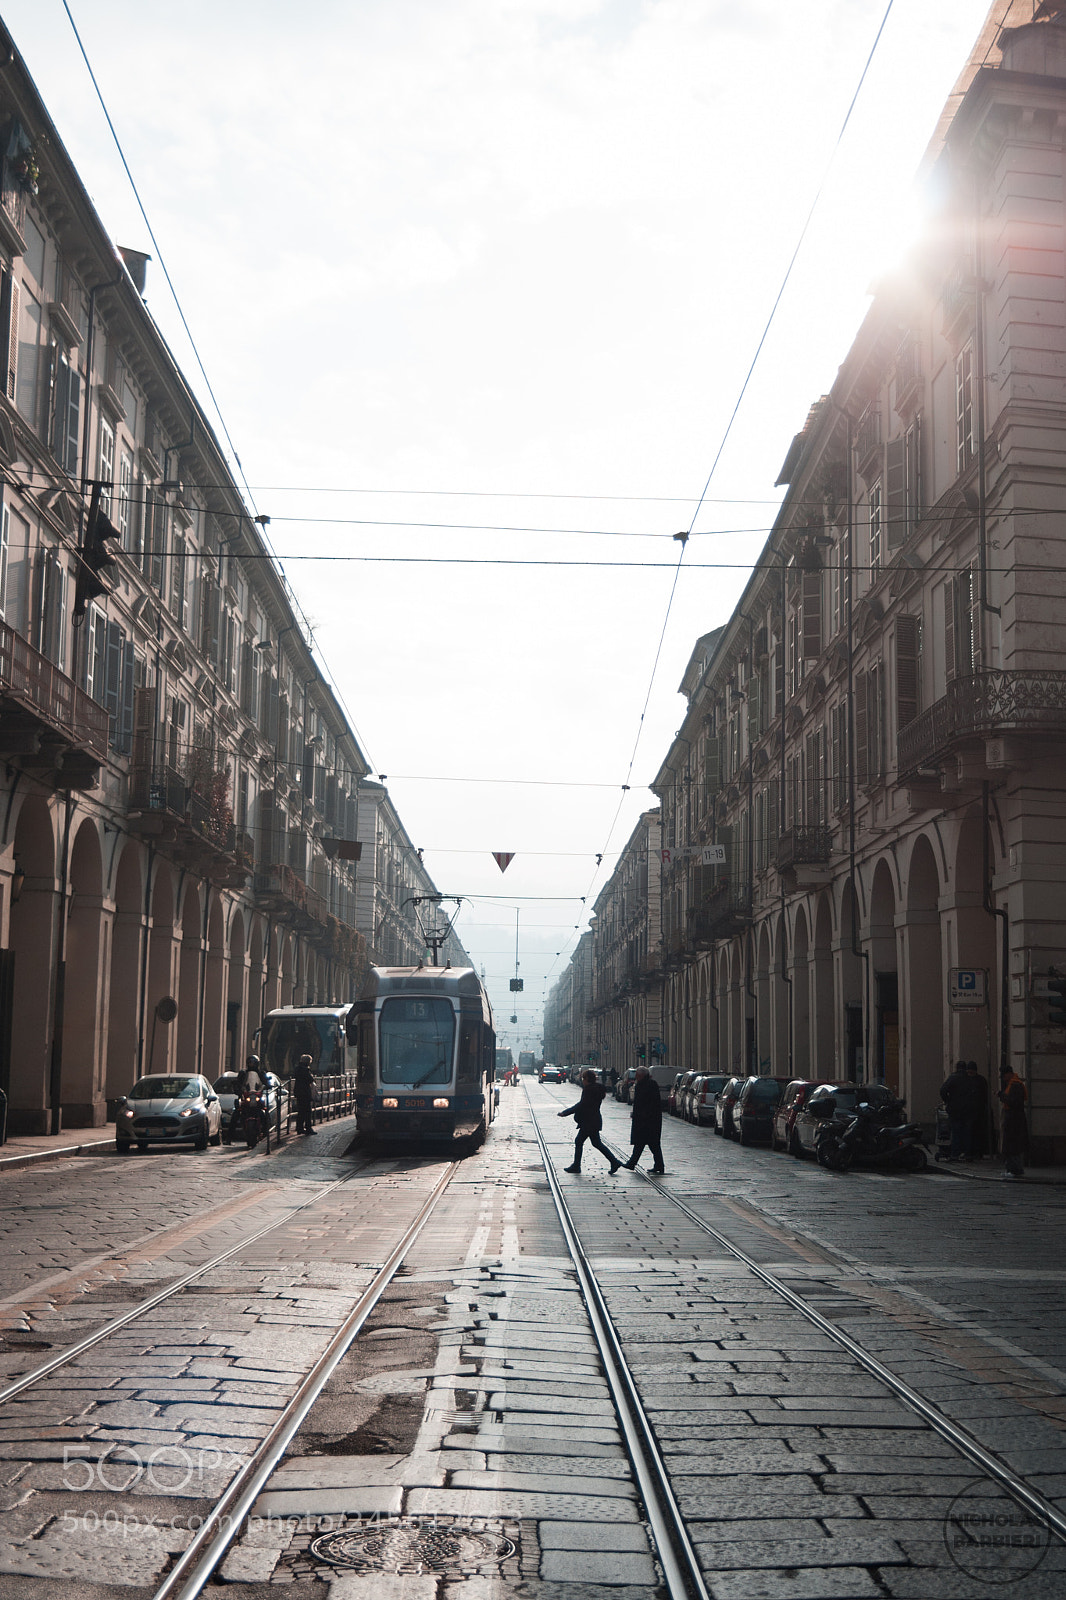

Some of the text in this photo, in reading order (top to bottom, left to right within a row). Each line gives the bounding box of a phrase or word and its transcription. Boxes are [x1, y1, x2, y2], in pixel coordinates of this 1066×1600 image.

[661, 849, 671, 864] R
[704, 849, 724, 860] 11-19
[962, 974, 973, 988] P
[412, 1003, 425, 1016] 13
[405, 1098, 426, 1107] 5019
